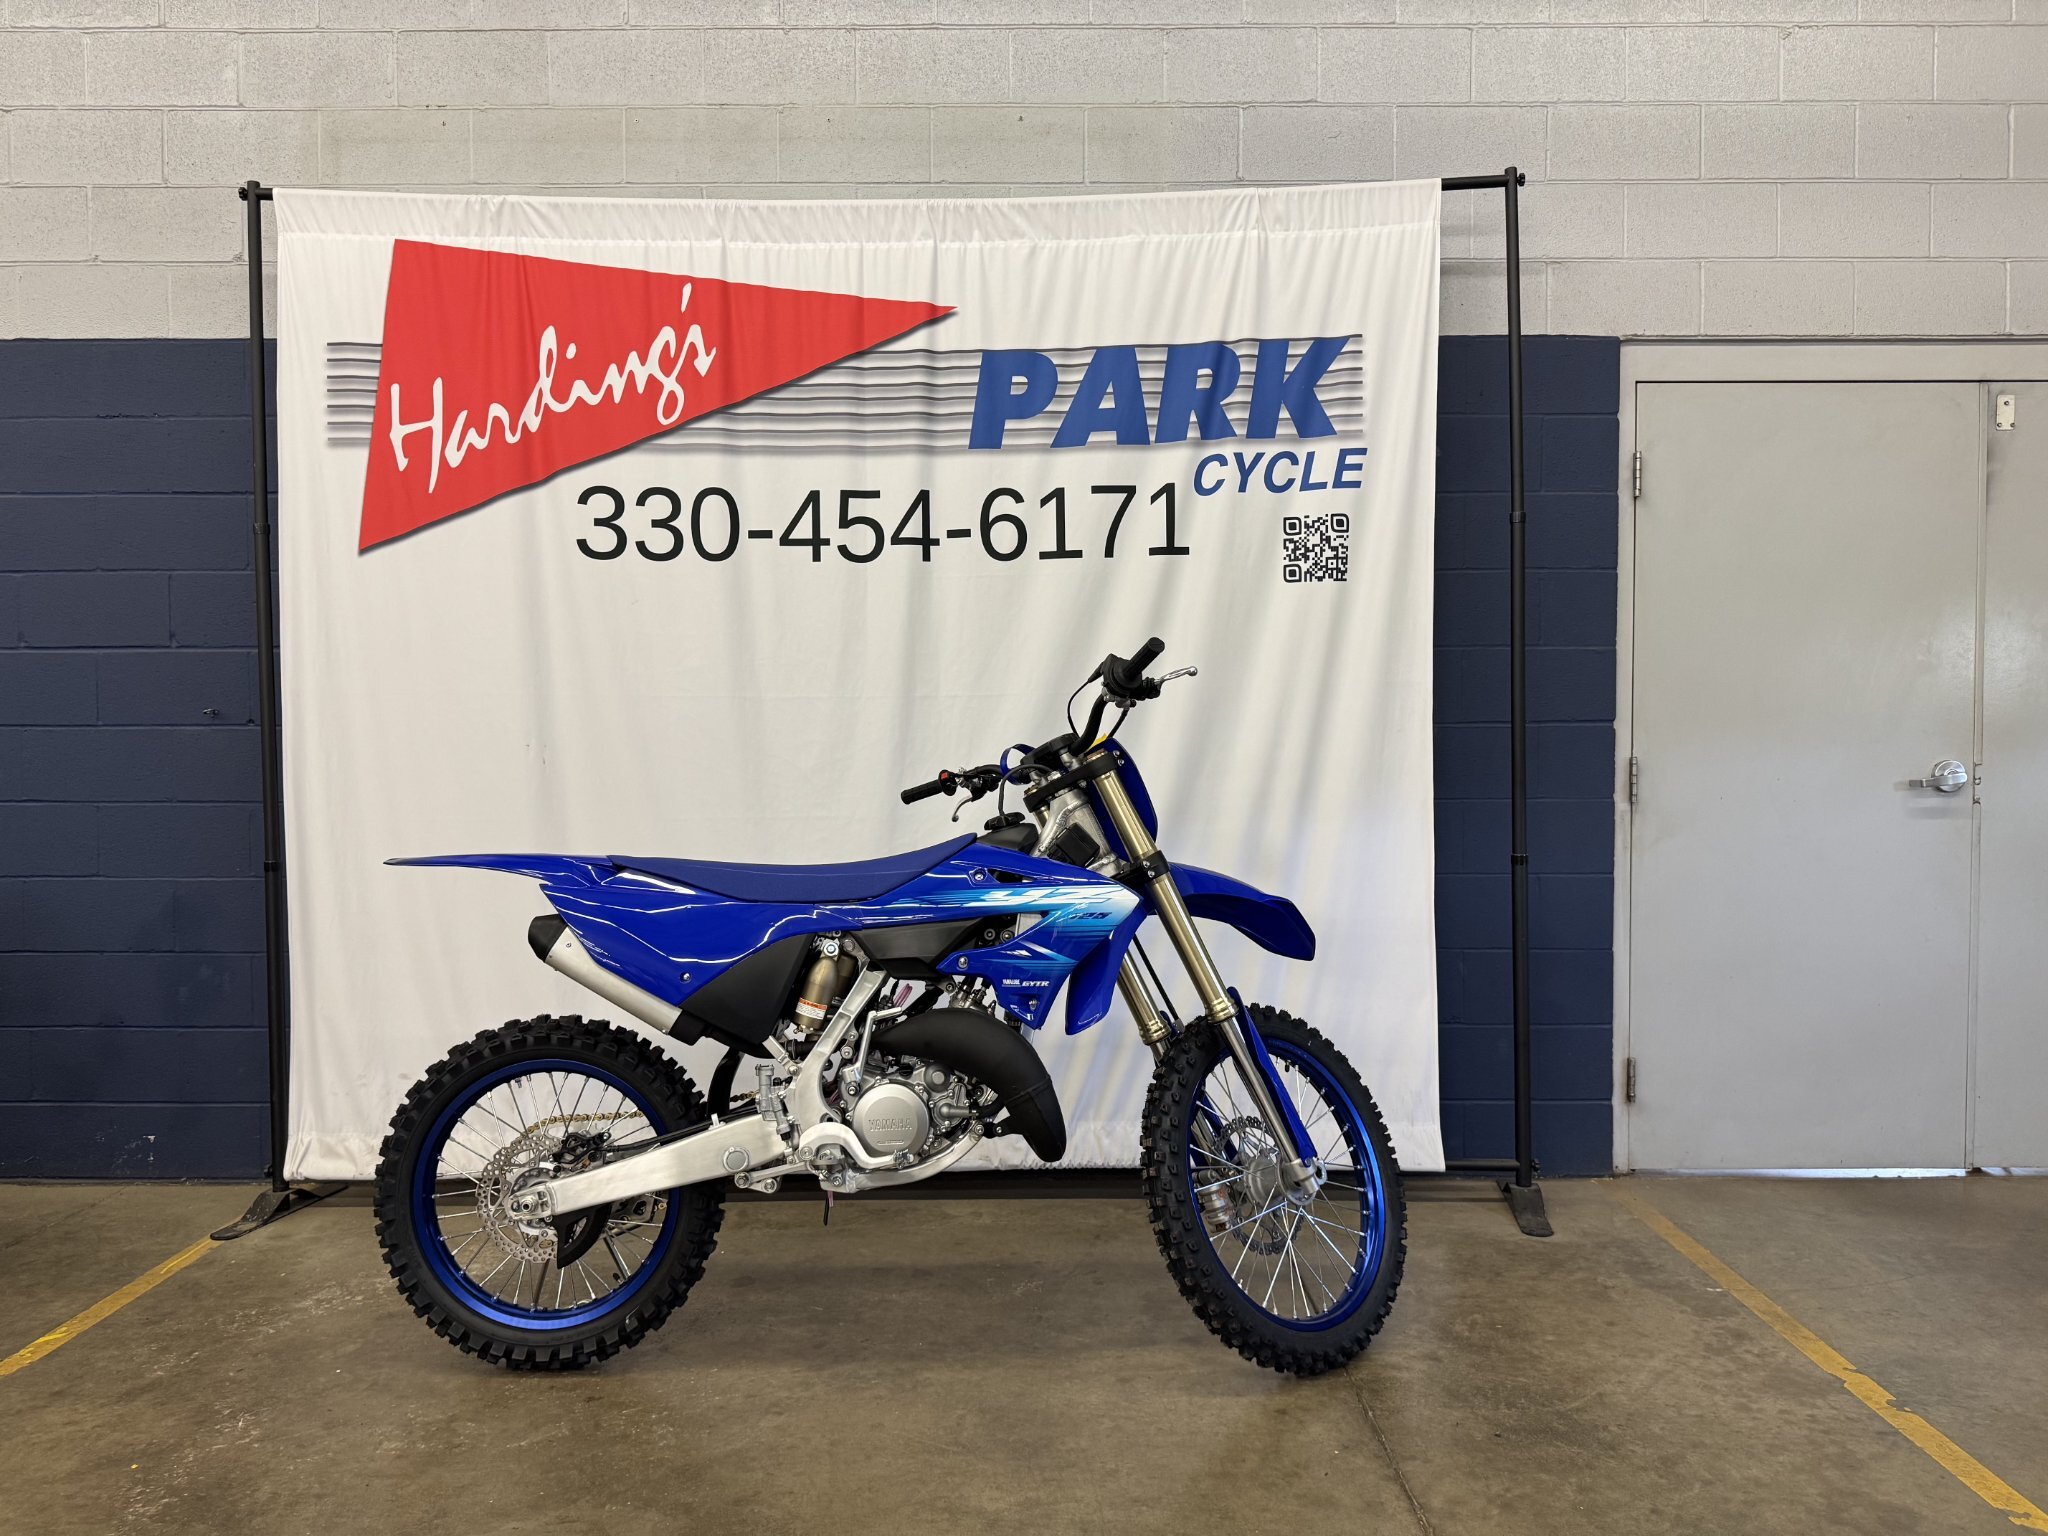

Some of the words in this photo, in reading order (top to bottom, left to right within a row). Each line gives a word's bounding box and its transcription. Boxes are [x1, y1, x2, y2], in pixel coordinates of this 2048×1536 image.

[389, 282, 717, 494] Harding's
[968, 336, 1351, 450] PARK
[1193, 447, 1368, 496] CYCLE
[575, 482, 1190, 563] 330-454-6171
[868, 1118, 912, 1131] YAMAHA
